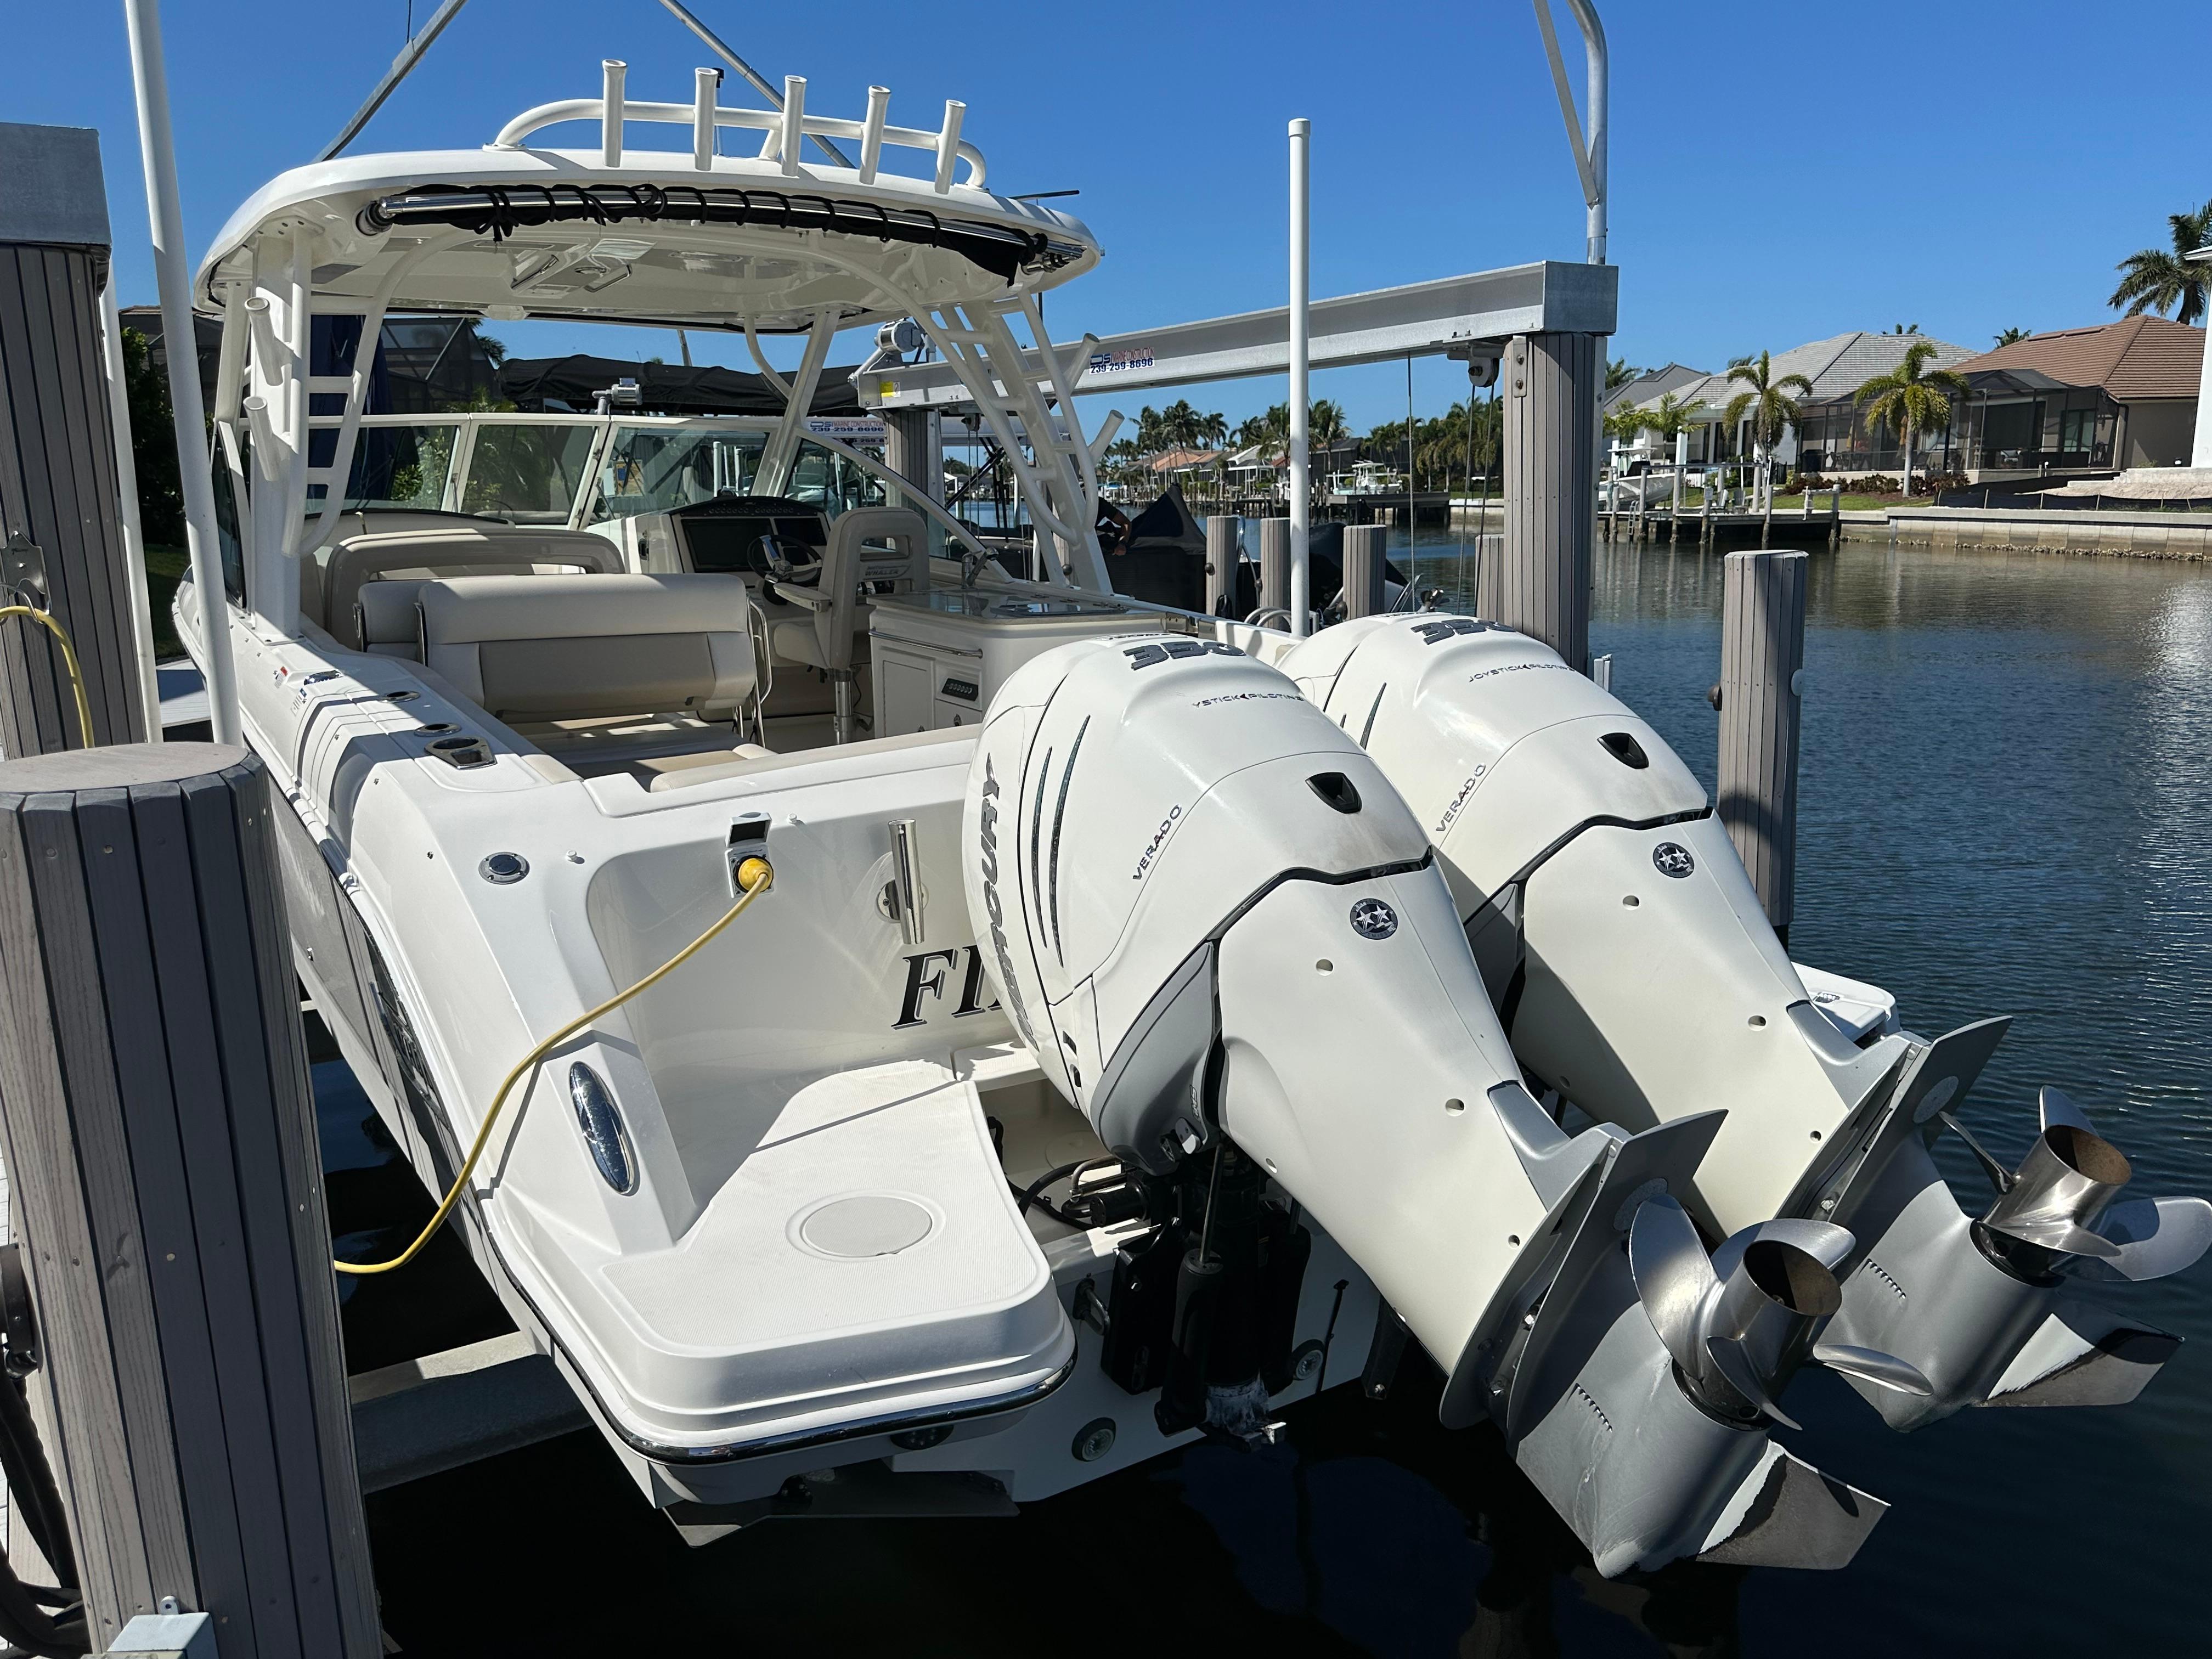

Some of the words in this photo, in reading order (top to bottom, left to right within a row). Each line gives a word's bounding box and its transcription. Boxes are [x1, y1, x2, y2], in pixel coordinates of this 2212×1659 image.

[1091, 358, 1153, 373] 239-259-8696
[1410, 618, 1516, 646] 350
[1122, 641, 1246, 670] 350
[1469, 665, 1523, 682] JOYSTICK
[1435, 764, 1486, 832] VERADO
[1133, 804, 1182, 880] VERADO
[981, 752, 1040, 1052] MERCURY
